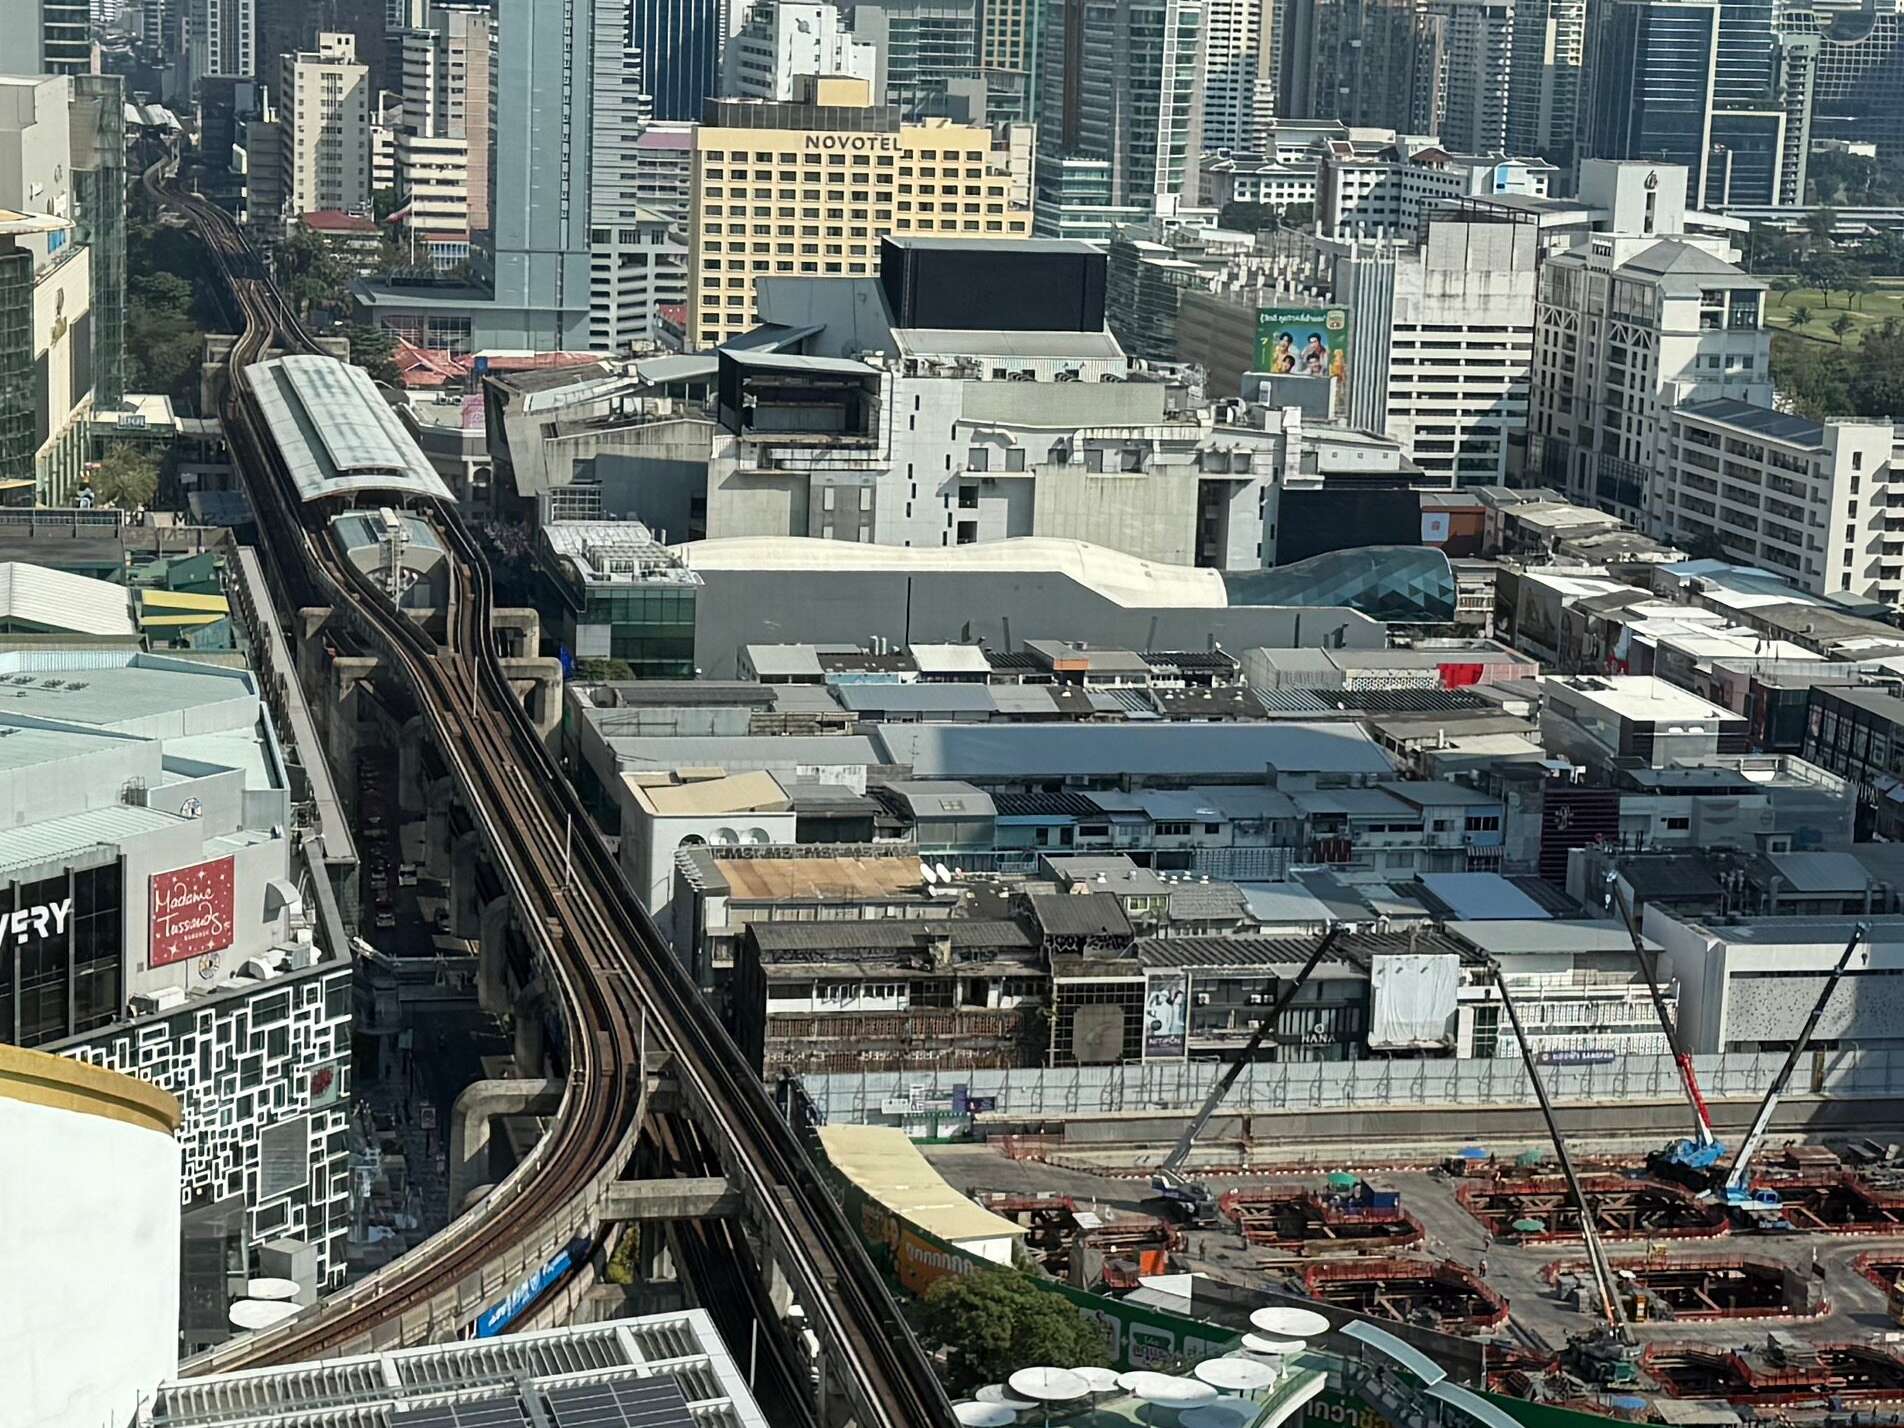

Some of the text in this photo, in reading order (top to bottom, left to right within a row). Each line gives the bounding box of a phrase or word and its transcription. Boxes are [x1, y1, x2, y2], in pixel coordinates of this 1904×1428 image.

[806, 135, 902, 151] NOVOTEL
[156, 882, 214, 913] Madame
[157, 901, 223, 937] Tussauds
